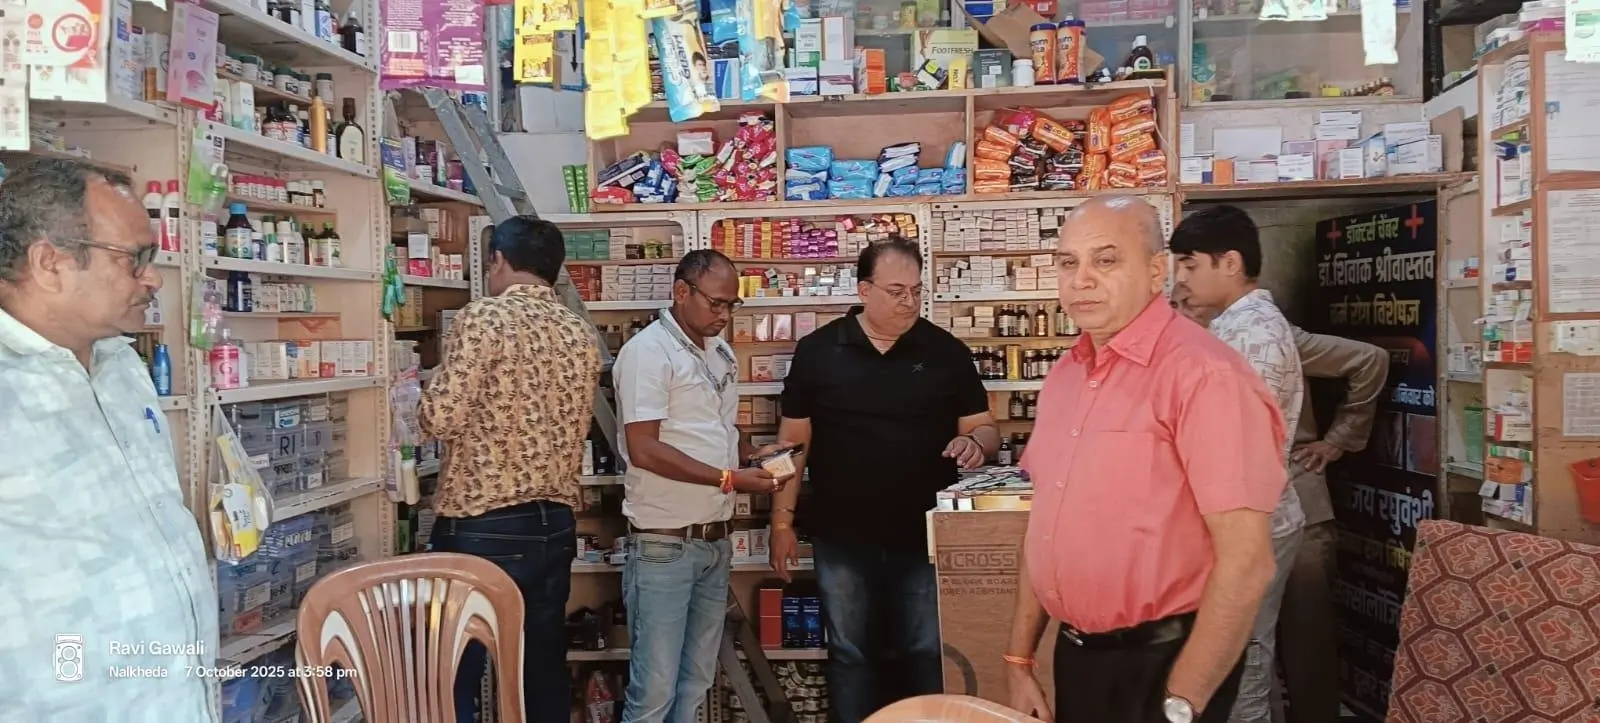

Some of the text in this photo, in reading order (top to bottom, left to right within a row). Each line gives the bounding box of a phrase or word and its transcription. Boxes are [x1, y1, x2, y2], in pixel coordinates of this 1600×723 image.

[1345, 214, 1400, 245] डॉक्टर्स चेंबर
[1375, 246, 1436, 283] श्रीवास्तव
[953, 552, 1016, 568] CROSS
